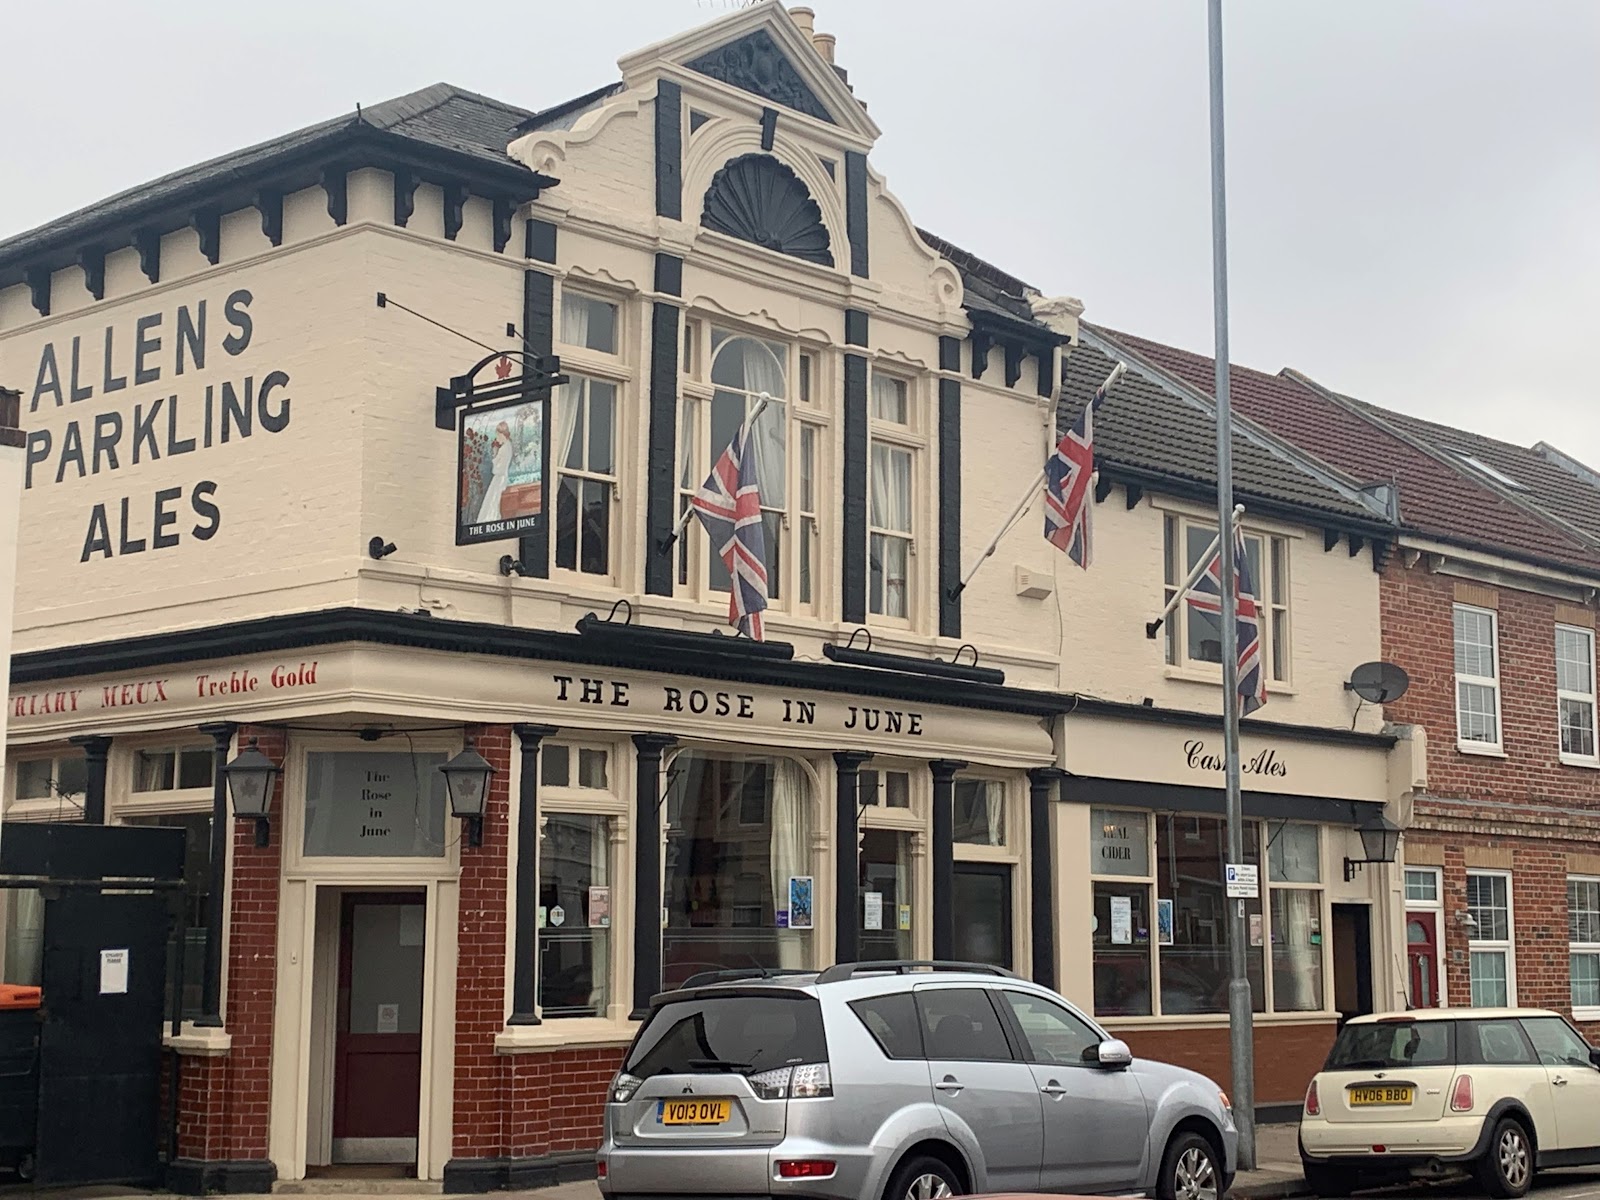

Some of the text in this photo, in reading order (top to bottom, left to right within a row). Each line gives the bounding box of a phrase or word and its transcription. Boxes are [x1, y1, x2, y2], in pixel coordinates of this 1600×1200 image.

[30, 289, 254, 412] ALLENS
[79, 481, 221, 563] ALES
[469, 517, 535, 535] THE ROSE IN JUNE
[9, 661, 318, 717] RIARY MEUX Treble Gold
[553, 675, 923, 736] THE ROSE IN JUNE
[1242, 748, 1288, 777] Ales
[365, 770, 391, 782] The
[361, 788, 392, 801] Rose
[370, 807, 382, 818] in
[359, 825, 391, 838] June
[1101, 845, 1132, 860] CIDER
[700, 1103, 725, 1119] OVL
